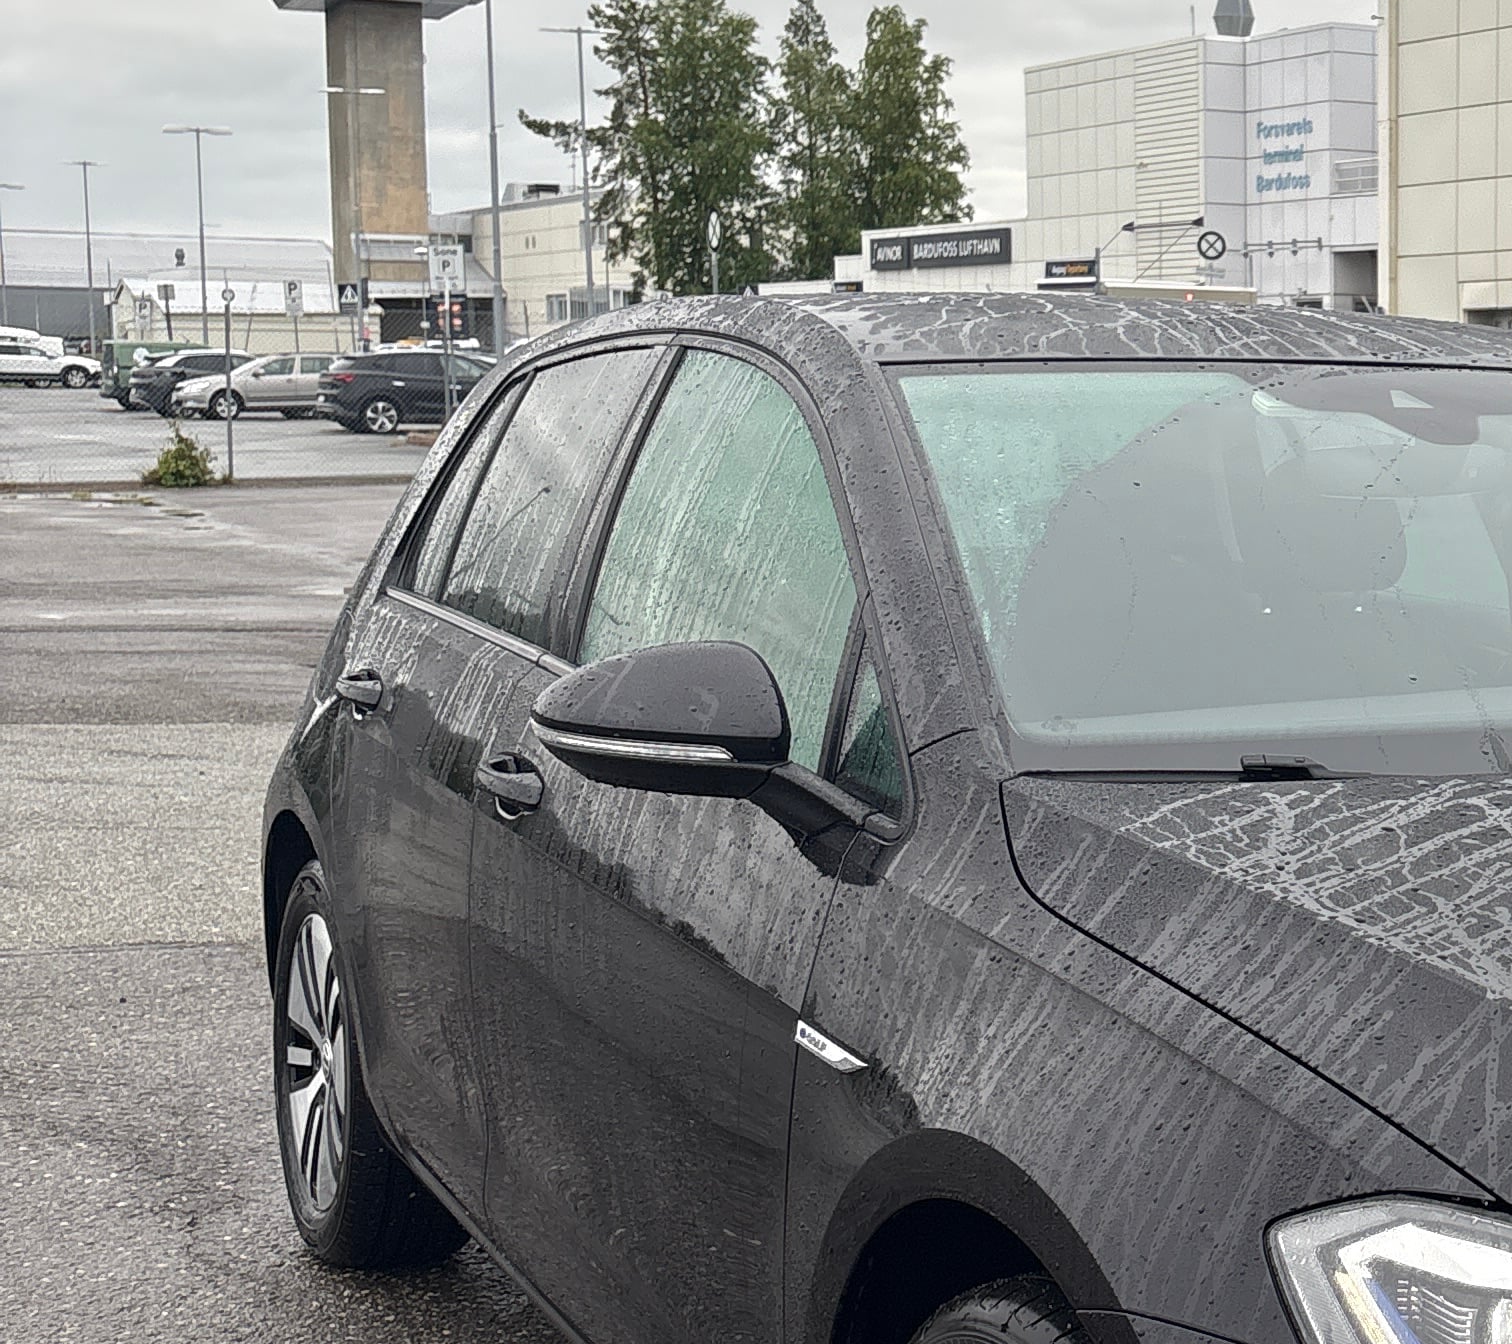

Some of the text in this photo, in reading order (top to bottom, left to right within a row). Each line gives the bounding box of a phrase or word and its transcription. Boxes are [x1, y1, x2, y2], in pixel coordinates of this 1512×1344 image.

[913, 238, 1001, 261] BARDUFOSS LUFTHAVN
[442, 259, 451, 273] P
[287, 282, 298, 296] P
